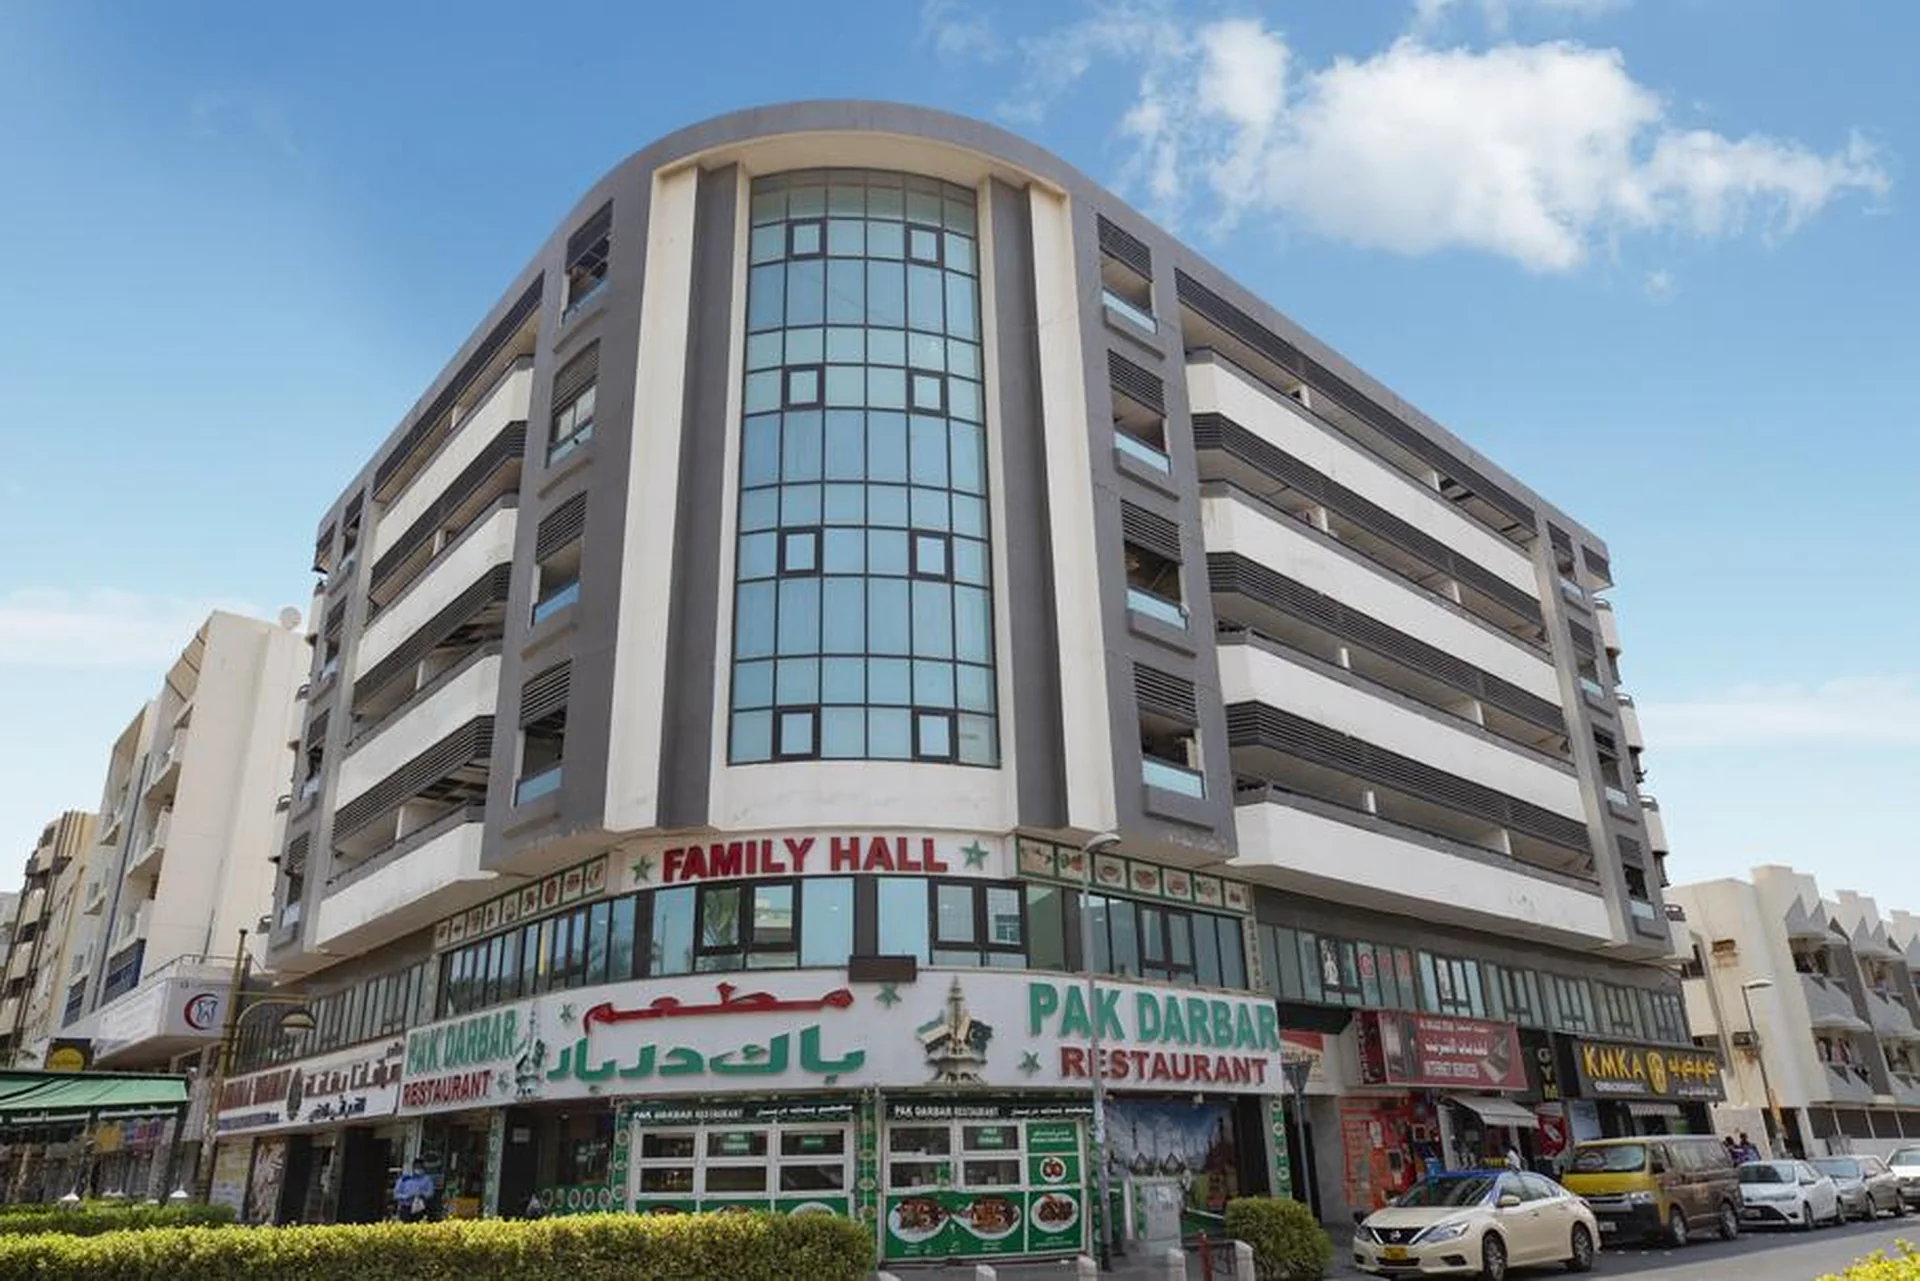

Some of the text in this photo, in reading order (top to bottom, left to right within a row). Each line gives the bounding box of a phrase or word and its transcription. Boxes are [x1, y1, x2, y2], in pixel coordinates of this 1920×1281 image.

[662, 836, 948, 883] FAMILY HALL
[583, 981, 855, 1035] مطعم
[1029, 982, 1281, 1051] PAK DARBAR
[405, 1008, 517, 1077] PAK DARBAR
[1582, 1043, 1647, 1080] KMKA
[1060, 1046, 1268, 1085] RESTAURANT
[402, 1069, 493, 1107] RESTAURANT
[894, 1104, 914, 1117] PAK
[915, 1105, 951, 1118] DARBAR
